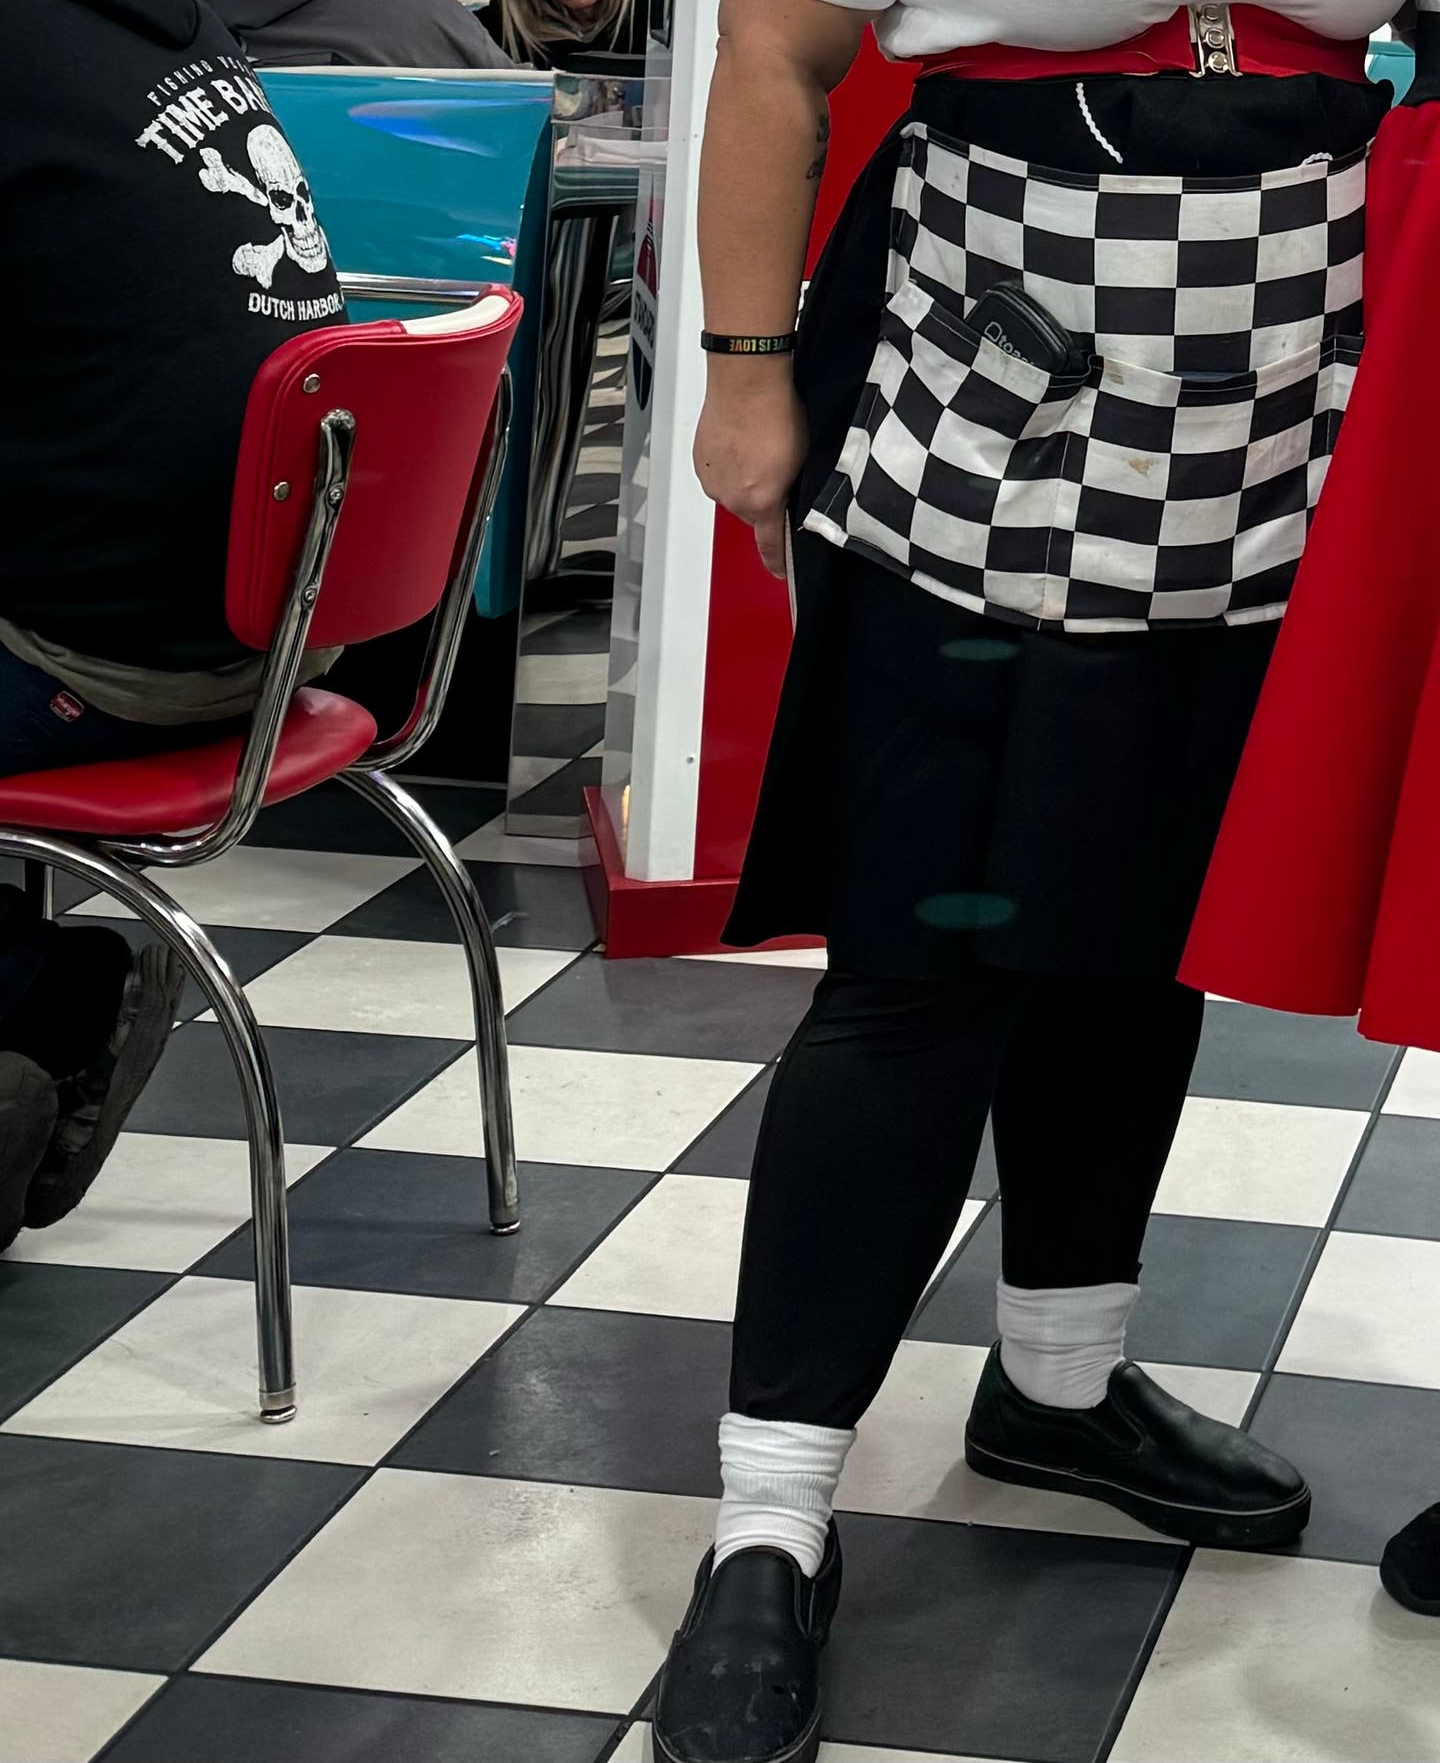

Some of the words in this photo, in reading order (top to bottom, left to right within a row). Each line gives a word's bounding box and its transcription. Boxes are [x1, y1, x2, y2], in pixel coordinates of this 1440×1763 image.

[134, 86, 230, 165] TIME
[247, 292, 295, 321] DUTCH
[728, 339, 758, 352] LOVE
